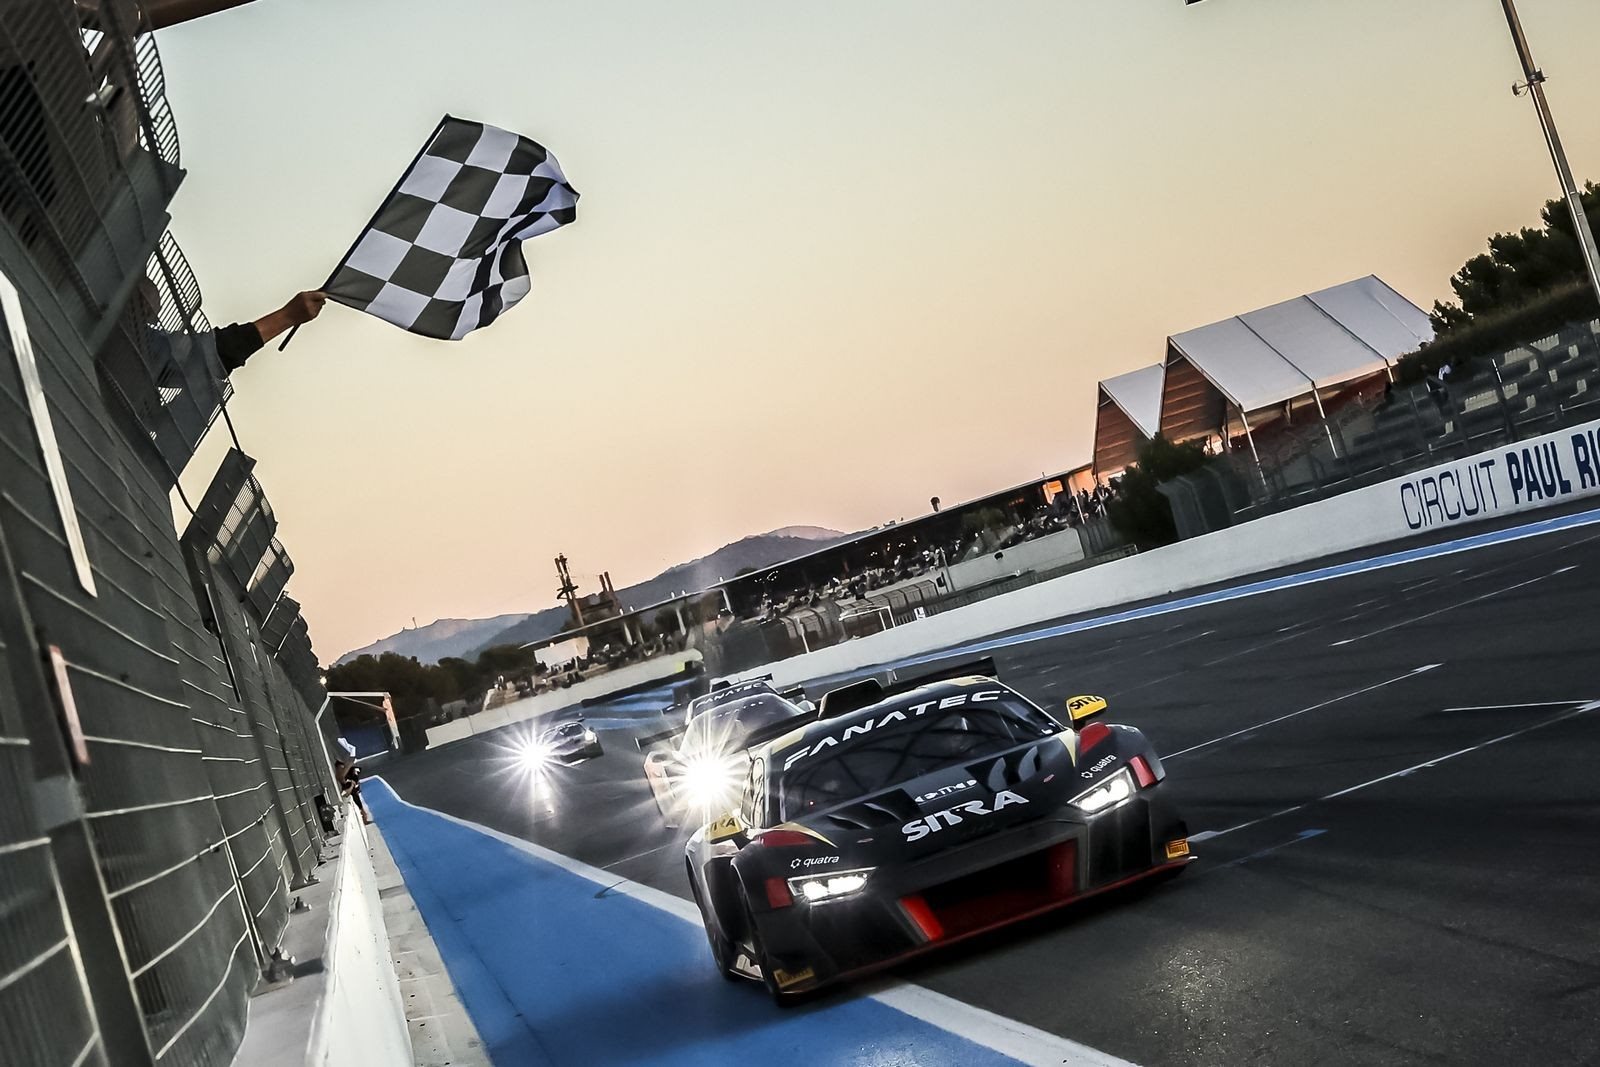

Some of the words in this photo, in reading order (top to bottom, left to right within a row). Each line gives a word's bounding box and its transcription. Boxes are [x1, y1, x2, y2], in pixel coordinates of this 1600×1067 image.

[1400, 459, 1498, 530] CIRCUIT
[1505, 441, 1572, 505] PAUL
[1571, 427, 1600, 489] RI
[783, 690, 1000, 771] FANATEC
[1090, 754, 1117, 771] quatra
[901, 790, 1030, 842] SITRA
[803, 855, 840, 868] quatra
